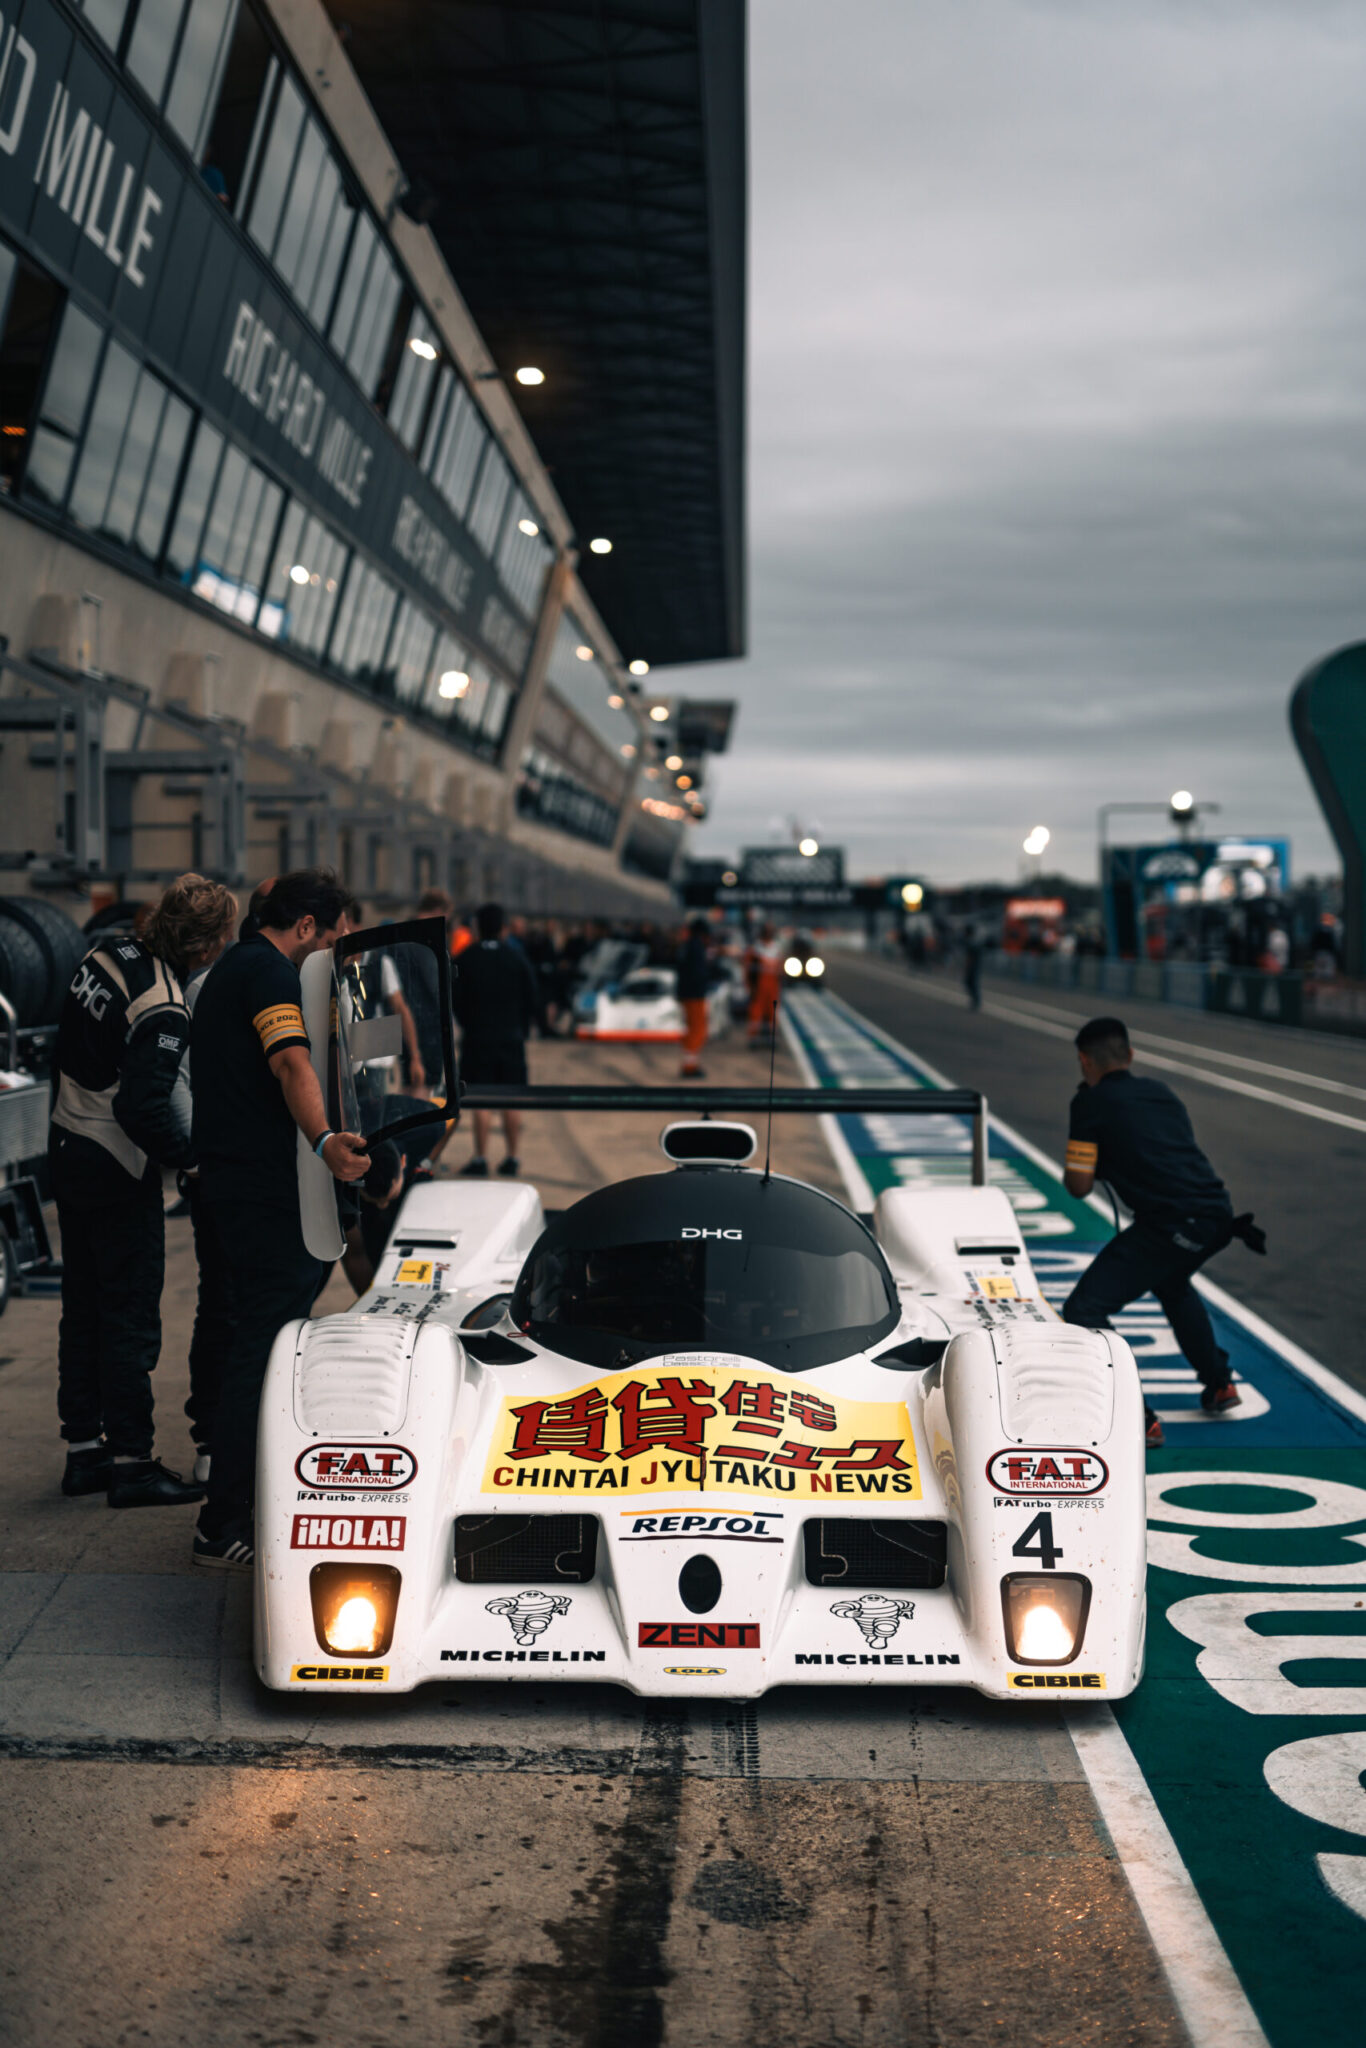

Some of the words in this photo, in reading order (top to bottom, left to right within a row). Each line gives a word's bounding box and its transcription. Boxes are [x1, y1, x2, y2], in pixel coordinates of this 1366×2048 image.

[34, 80, 163, 289] MILLE
[223, 300, 326, 457] RICHARD
[69, 964, 113, 1022] DHG
[158, 1036, 180, 1049] OMP
[681, 1227, 743, 1241] DHG
[316, 1475, 395, 1485] INTERNATIONAL
[492, 1464, 630, 1489] CHINTAI
[640, 1458, 797, 1492] JYUTAKU
[810, 1472, 914, 1494] NEWS
[1010, 1480, 1089, 1490] INTERNATIONAL
[297, 1517, 401, 1548] ¡HOLA!
[631, 1515, 770, 1535] REPSOL
[1011, 1511, 1064, 1570] 4
[641, 1624, 757, 1646] ZENT
[439, 1649, 606, 1662] MICHELIN
[794, 1653, 961, 1666] MICHELIN
